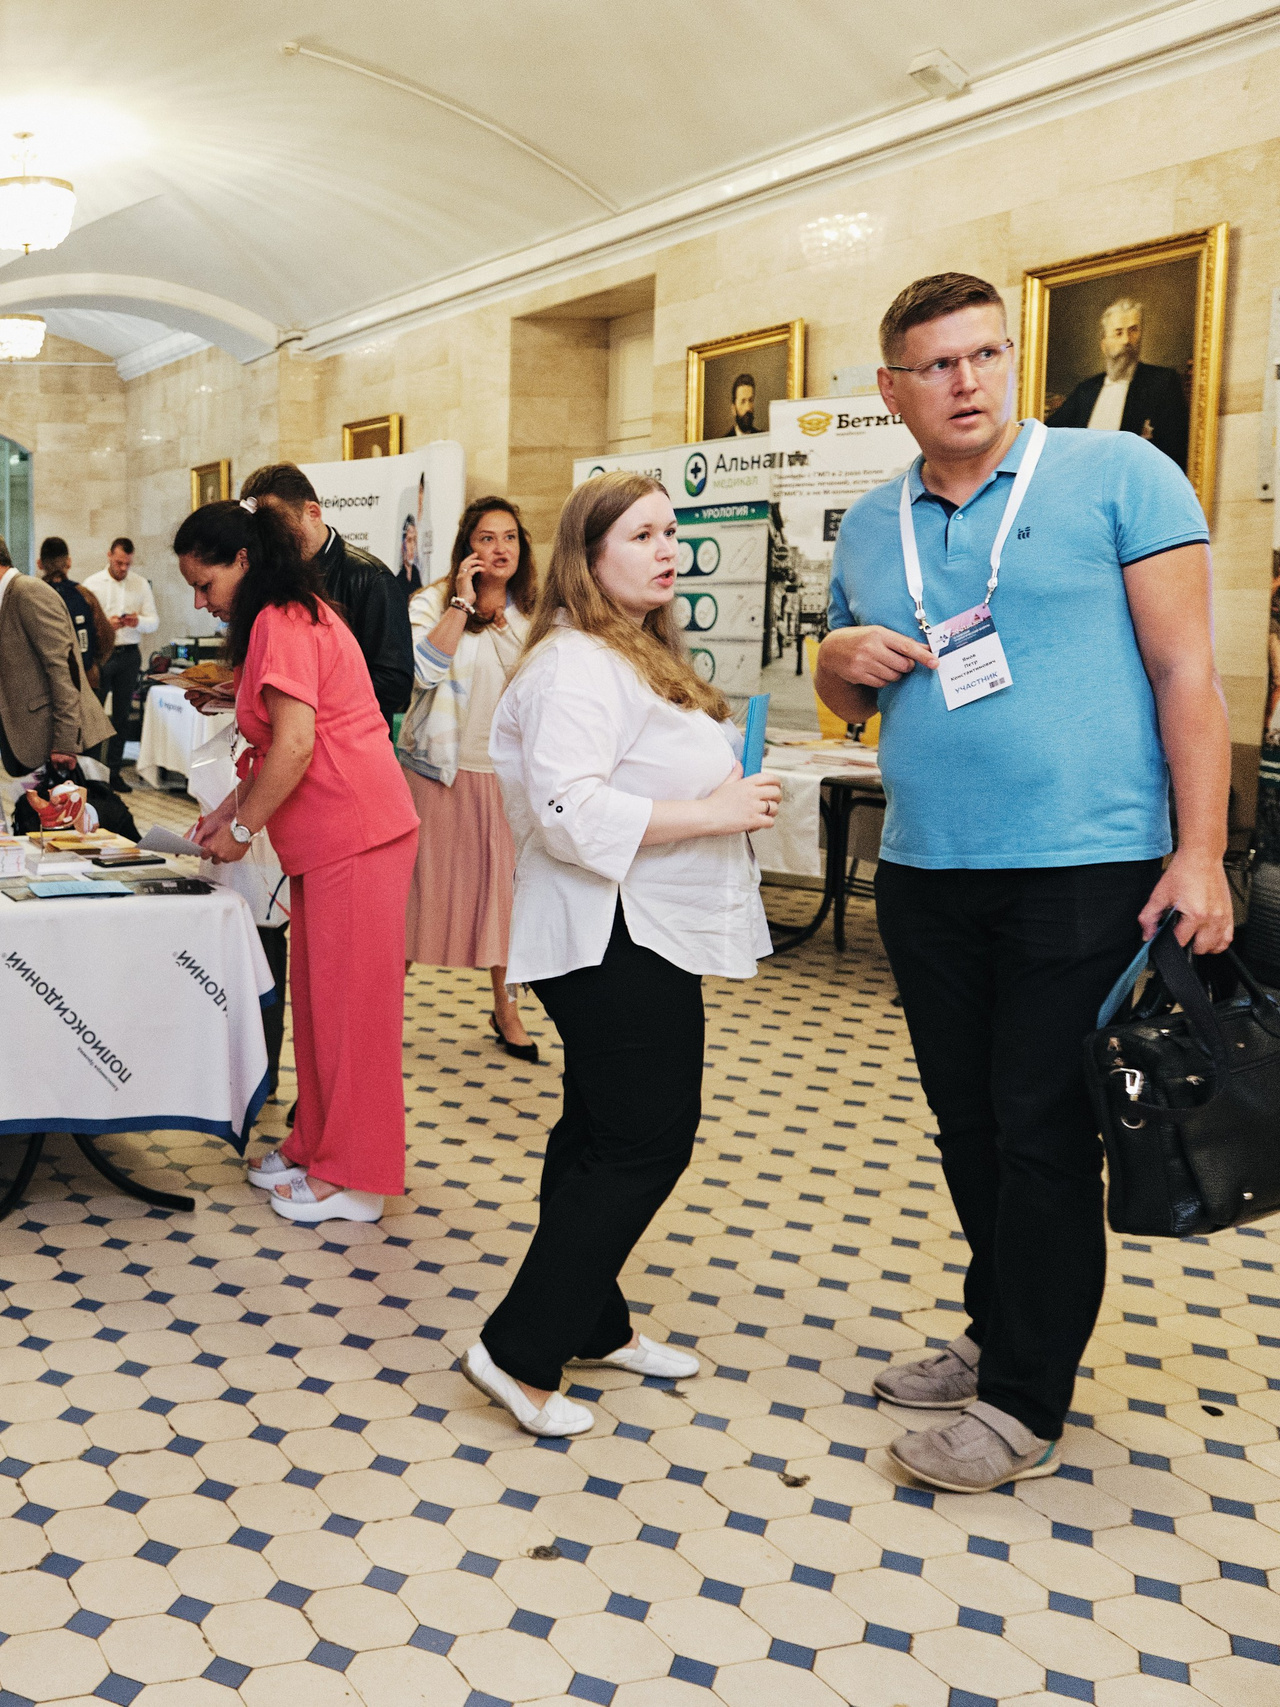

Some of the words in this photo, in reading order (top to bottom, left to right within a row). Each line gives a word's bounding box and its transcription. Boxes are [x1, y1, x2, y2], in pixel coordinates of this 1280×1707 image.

[702, 506, 748, 519] УРОЛОГИЯ
[955, 672, 998, 693] УЧАСТНИК
[5, 951, 132, 1083] ПОЛИОКСИДОНИЙ
